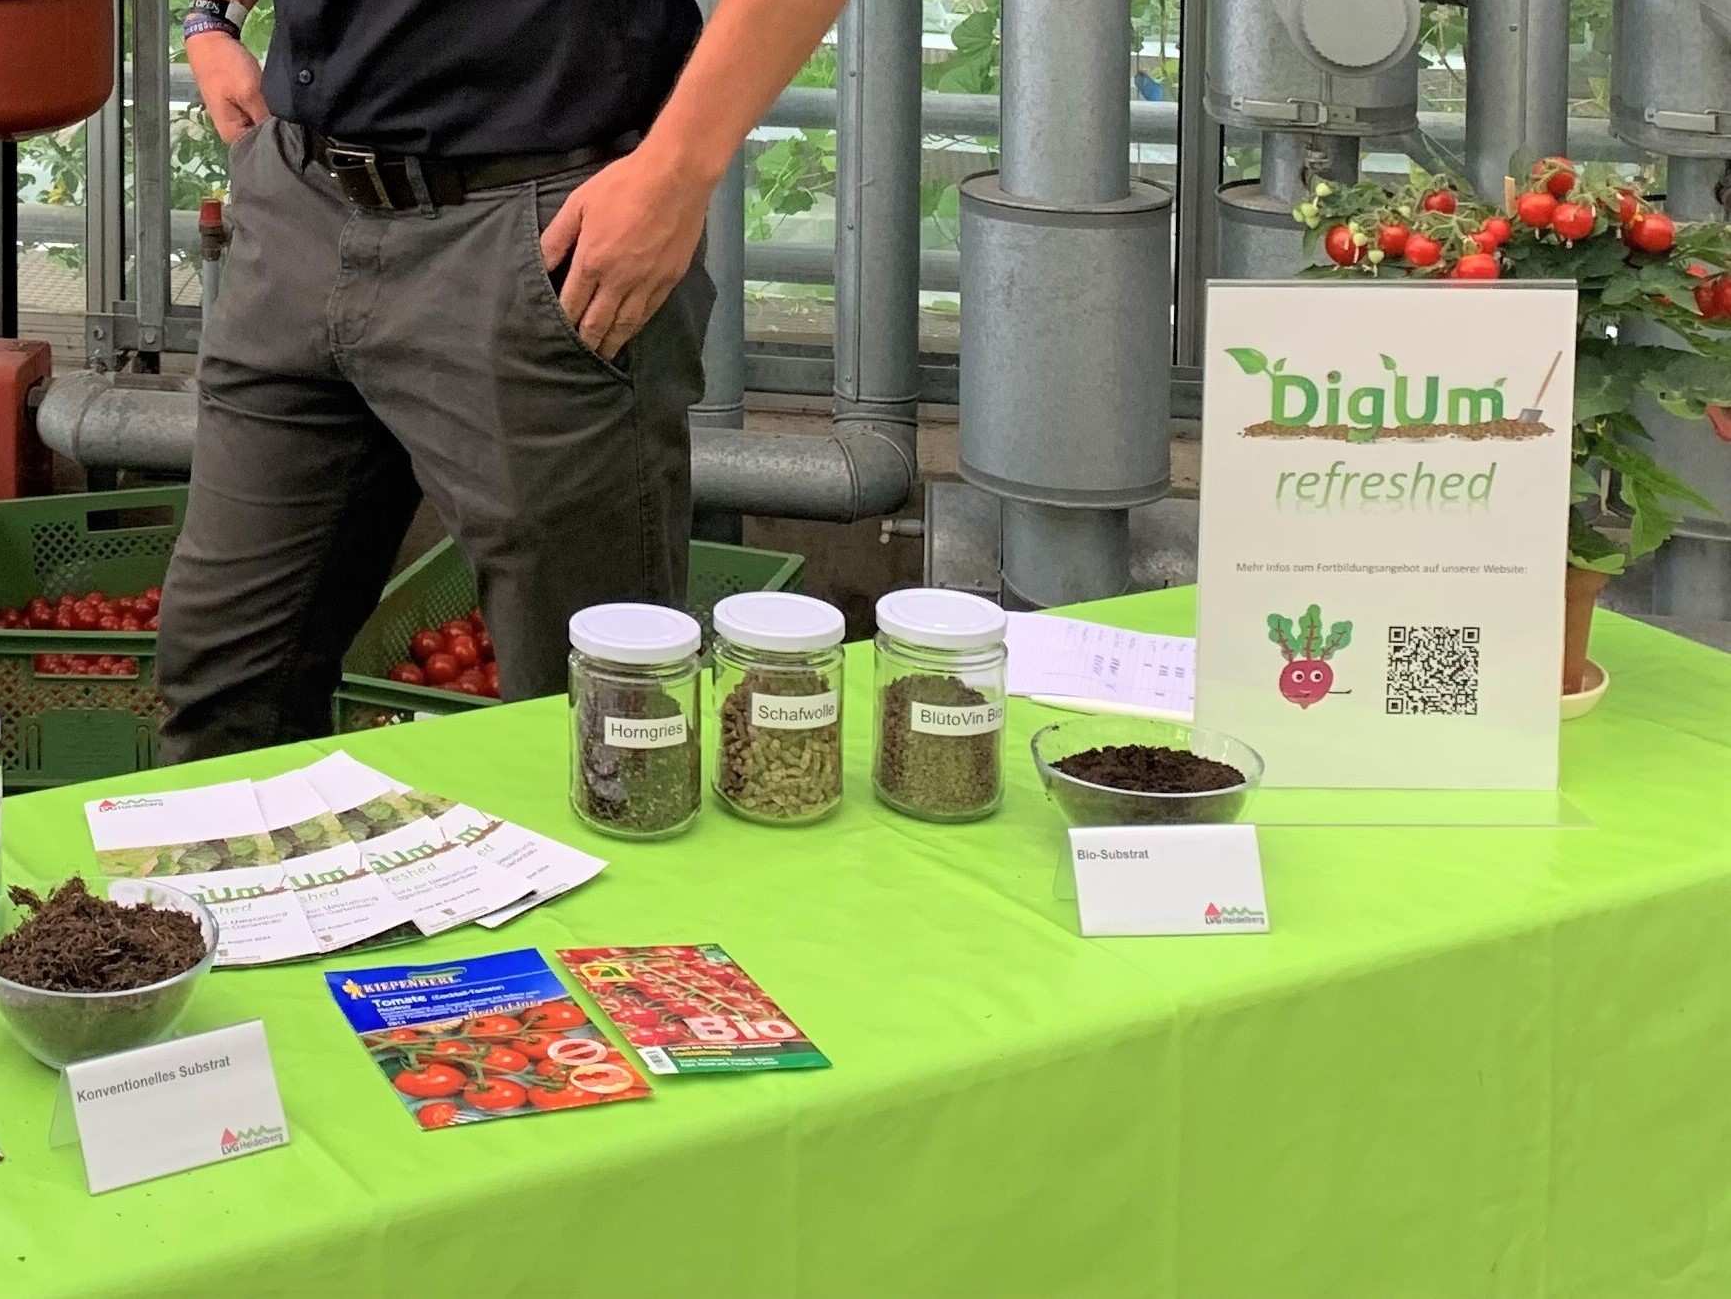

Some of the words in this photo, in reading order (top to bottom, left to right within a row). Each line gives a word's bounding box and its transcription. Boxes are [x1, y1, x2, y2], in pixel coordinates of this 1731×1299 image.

[1271, 369, 1505, 444] DigUm
[1275, 462, 1497, 507] refreshed
[1235, 562, 1264, 573] Mehr
[1266, 562, 1291, 573] Infos
[1293, 565, 1314, 573] zum
[1316, 562, 1421, 575] Fortbildungsangebot
[1422, 563, 1440, 574] auf
[1442, 565, 1481, 574] unserer
[1483, 563, 1528, 575] Website:
[758, 703, 836, 722] Schafwolle
[920, 706, 984, 724] BlütoVin
[610, 722, 684, 742] Horngries
[1077, 849, 1150, 861] Bio-Substrat
[372, 994, 428, 1008] Tomate
[683, 1014, 798, 1042] Bio
[76, 1070, 177, 1103] Konventionelles
[178, 1055, 231, 1078] Substrat
[221, 1141, 241, 1156] LVG
[240, 1132, 285, 1150] Heidelberg
